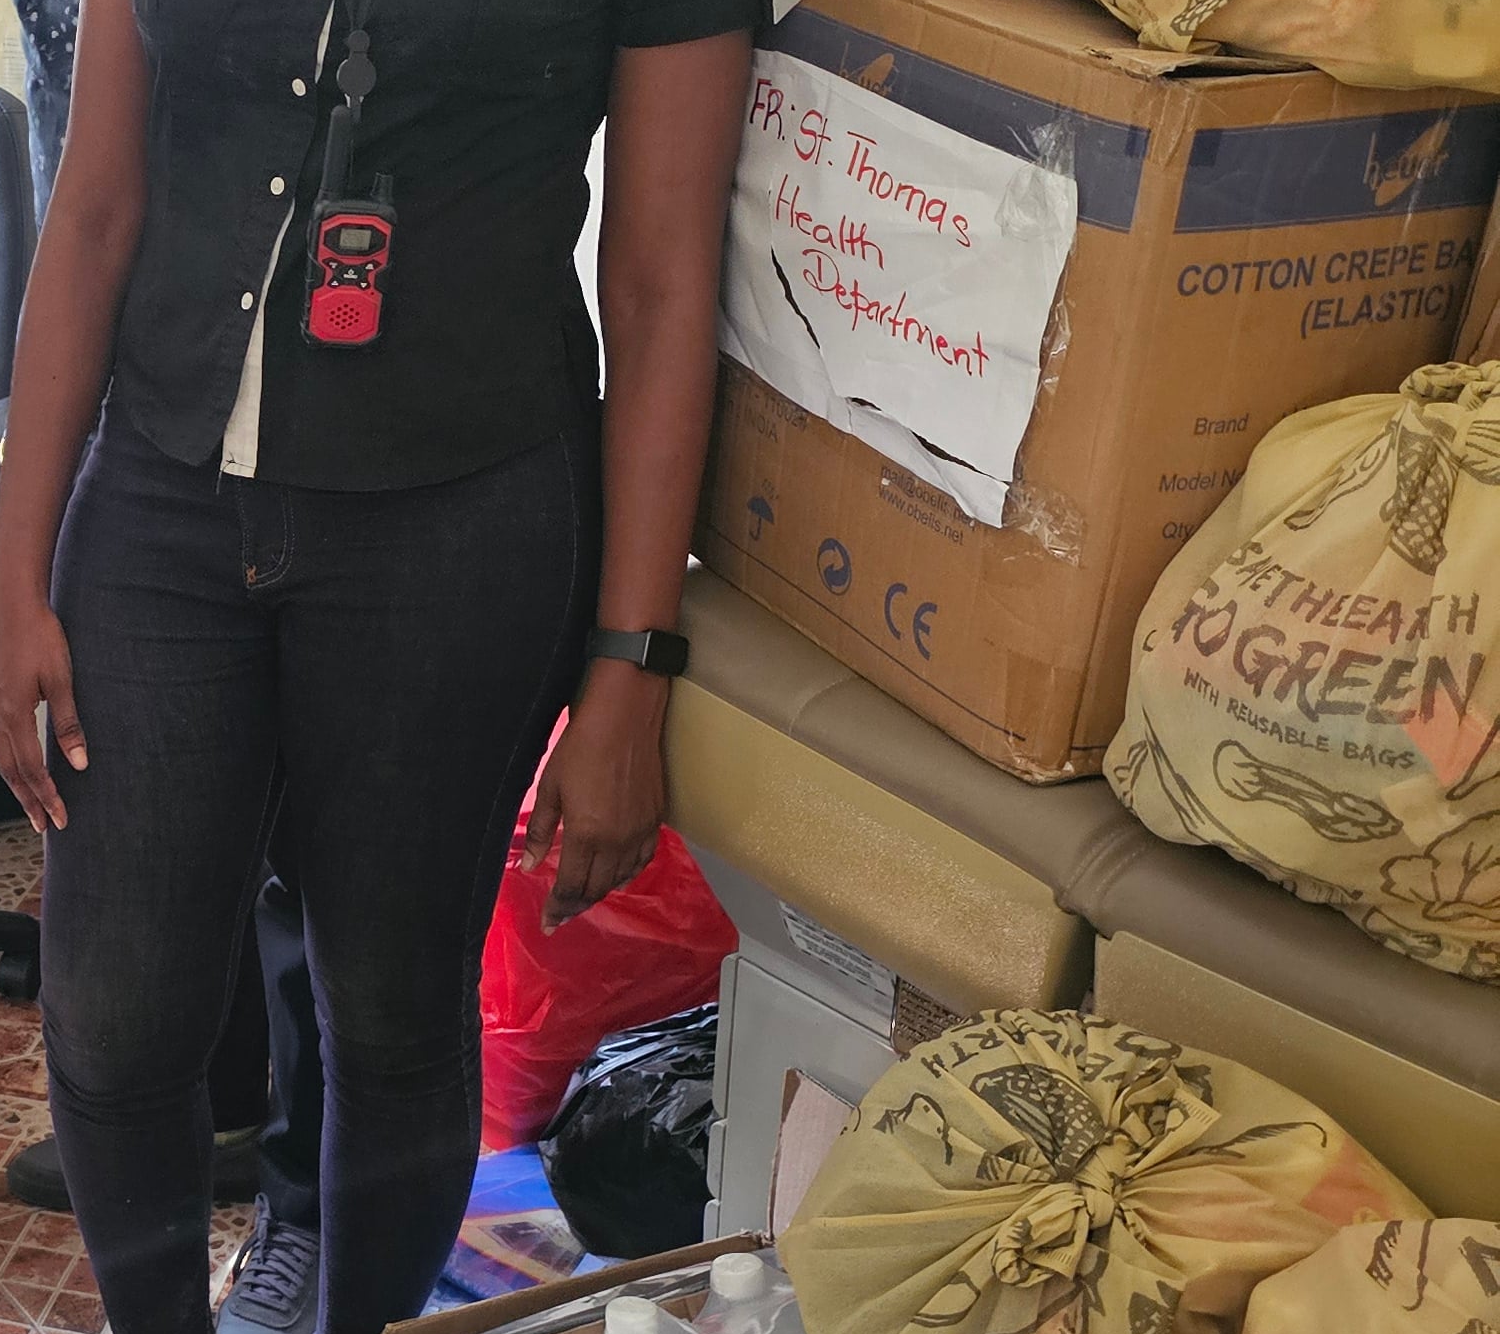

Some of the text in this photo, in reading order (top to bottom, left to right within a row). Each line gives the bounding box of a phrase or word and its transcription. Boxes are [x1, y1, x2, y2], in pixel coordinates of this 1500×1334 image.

[775, 173, 885, 271] Health
[794, 109, 833, 166] St.
[847, 131, 972, 248] Thomas
[802, 248, 990, 378] Department
[1177, 235, 1479, 297] COTTON CREPE BA
[1193, 412, 1250, 436] Brand
[1158, 470, 1218, 493] Model
[1184, 666, 1416, 769] WITH REUSABLE BAGS
[1232, 623, 1486, 727] GREEN
